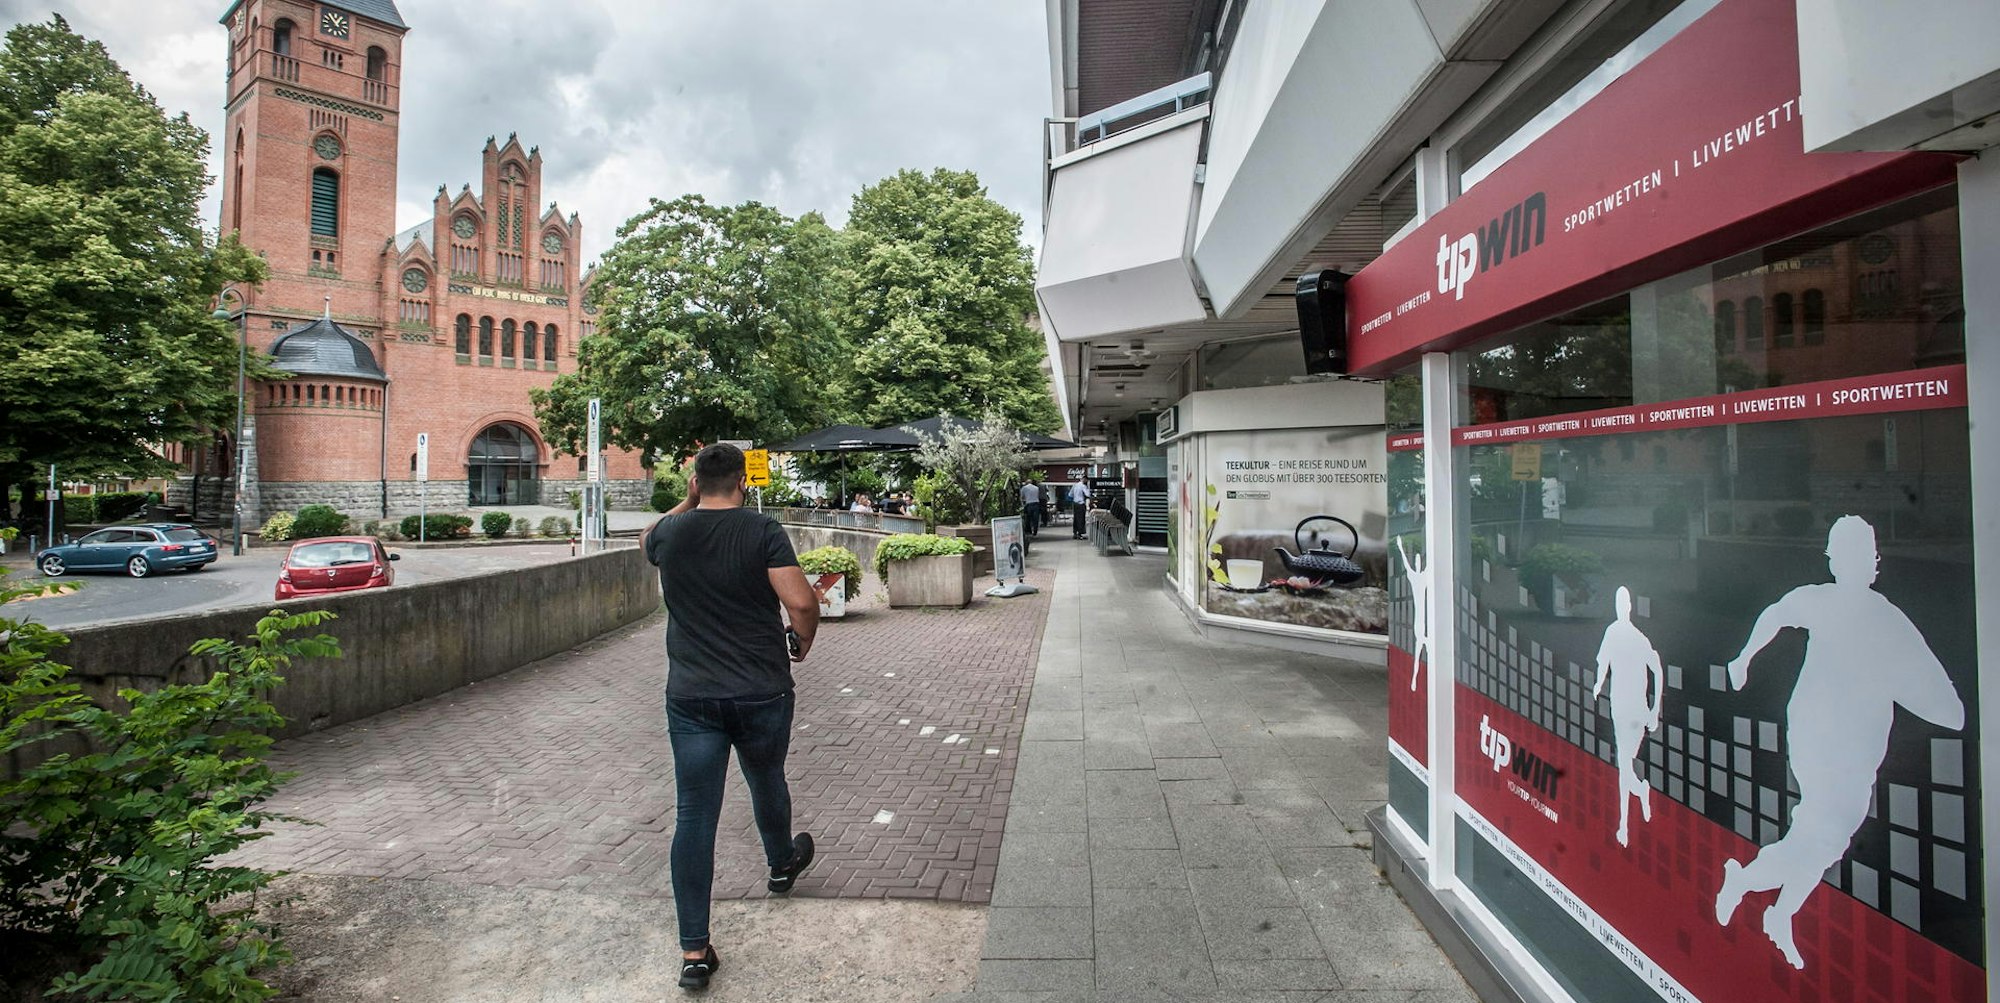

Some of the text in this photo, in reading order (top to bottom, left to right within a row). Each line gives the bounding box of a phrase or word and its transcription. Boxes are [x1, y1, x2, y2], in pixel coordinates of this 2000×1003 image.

[1564, 170, 1661, 233] SPORTWETTEN
[1693, 95, 1802, 168] LIVEWETT
[1436, 192, 1546, 301] tipwin
[1361, 290, 1431, 335] SPORTWETTEN LIVEWETTEN
[1500, 426, 1529, 437] LIVEWETTEN
[1538, 420, 1580, 433] SPORTWETTEN
[1592, 414, 1635, 428] LIVEWETTEN
[1650, 405, 1714, 423] SPORTWETTEN
[1734, 396, 1806, 415] LIVEWETTEN
[1832, 380, 1949, 405] SPORTWETTEN
[1226, 461, 1270, 470] TEEKULTUR
[1278, 461, 1297, 470] EINE
[1299, 460, 1322, 470] REISE
[1324, 460, 1350, 469] RUND
[1352, 460, 1367, 469] UM
[1226, 472, 1387, 483] DEN GLOBUS MIT ÜBER 300 TEESORTEN
[1480, 714, 1559, 800] tipwin
[1506, 844, 1536, 875] LIVEWETTEN
[1546, 879, 1587, 921] SPORTWETTEN
[1600, 926, 1644, 971] LIVEWETTEN
